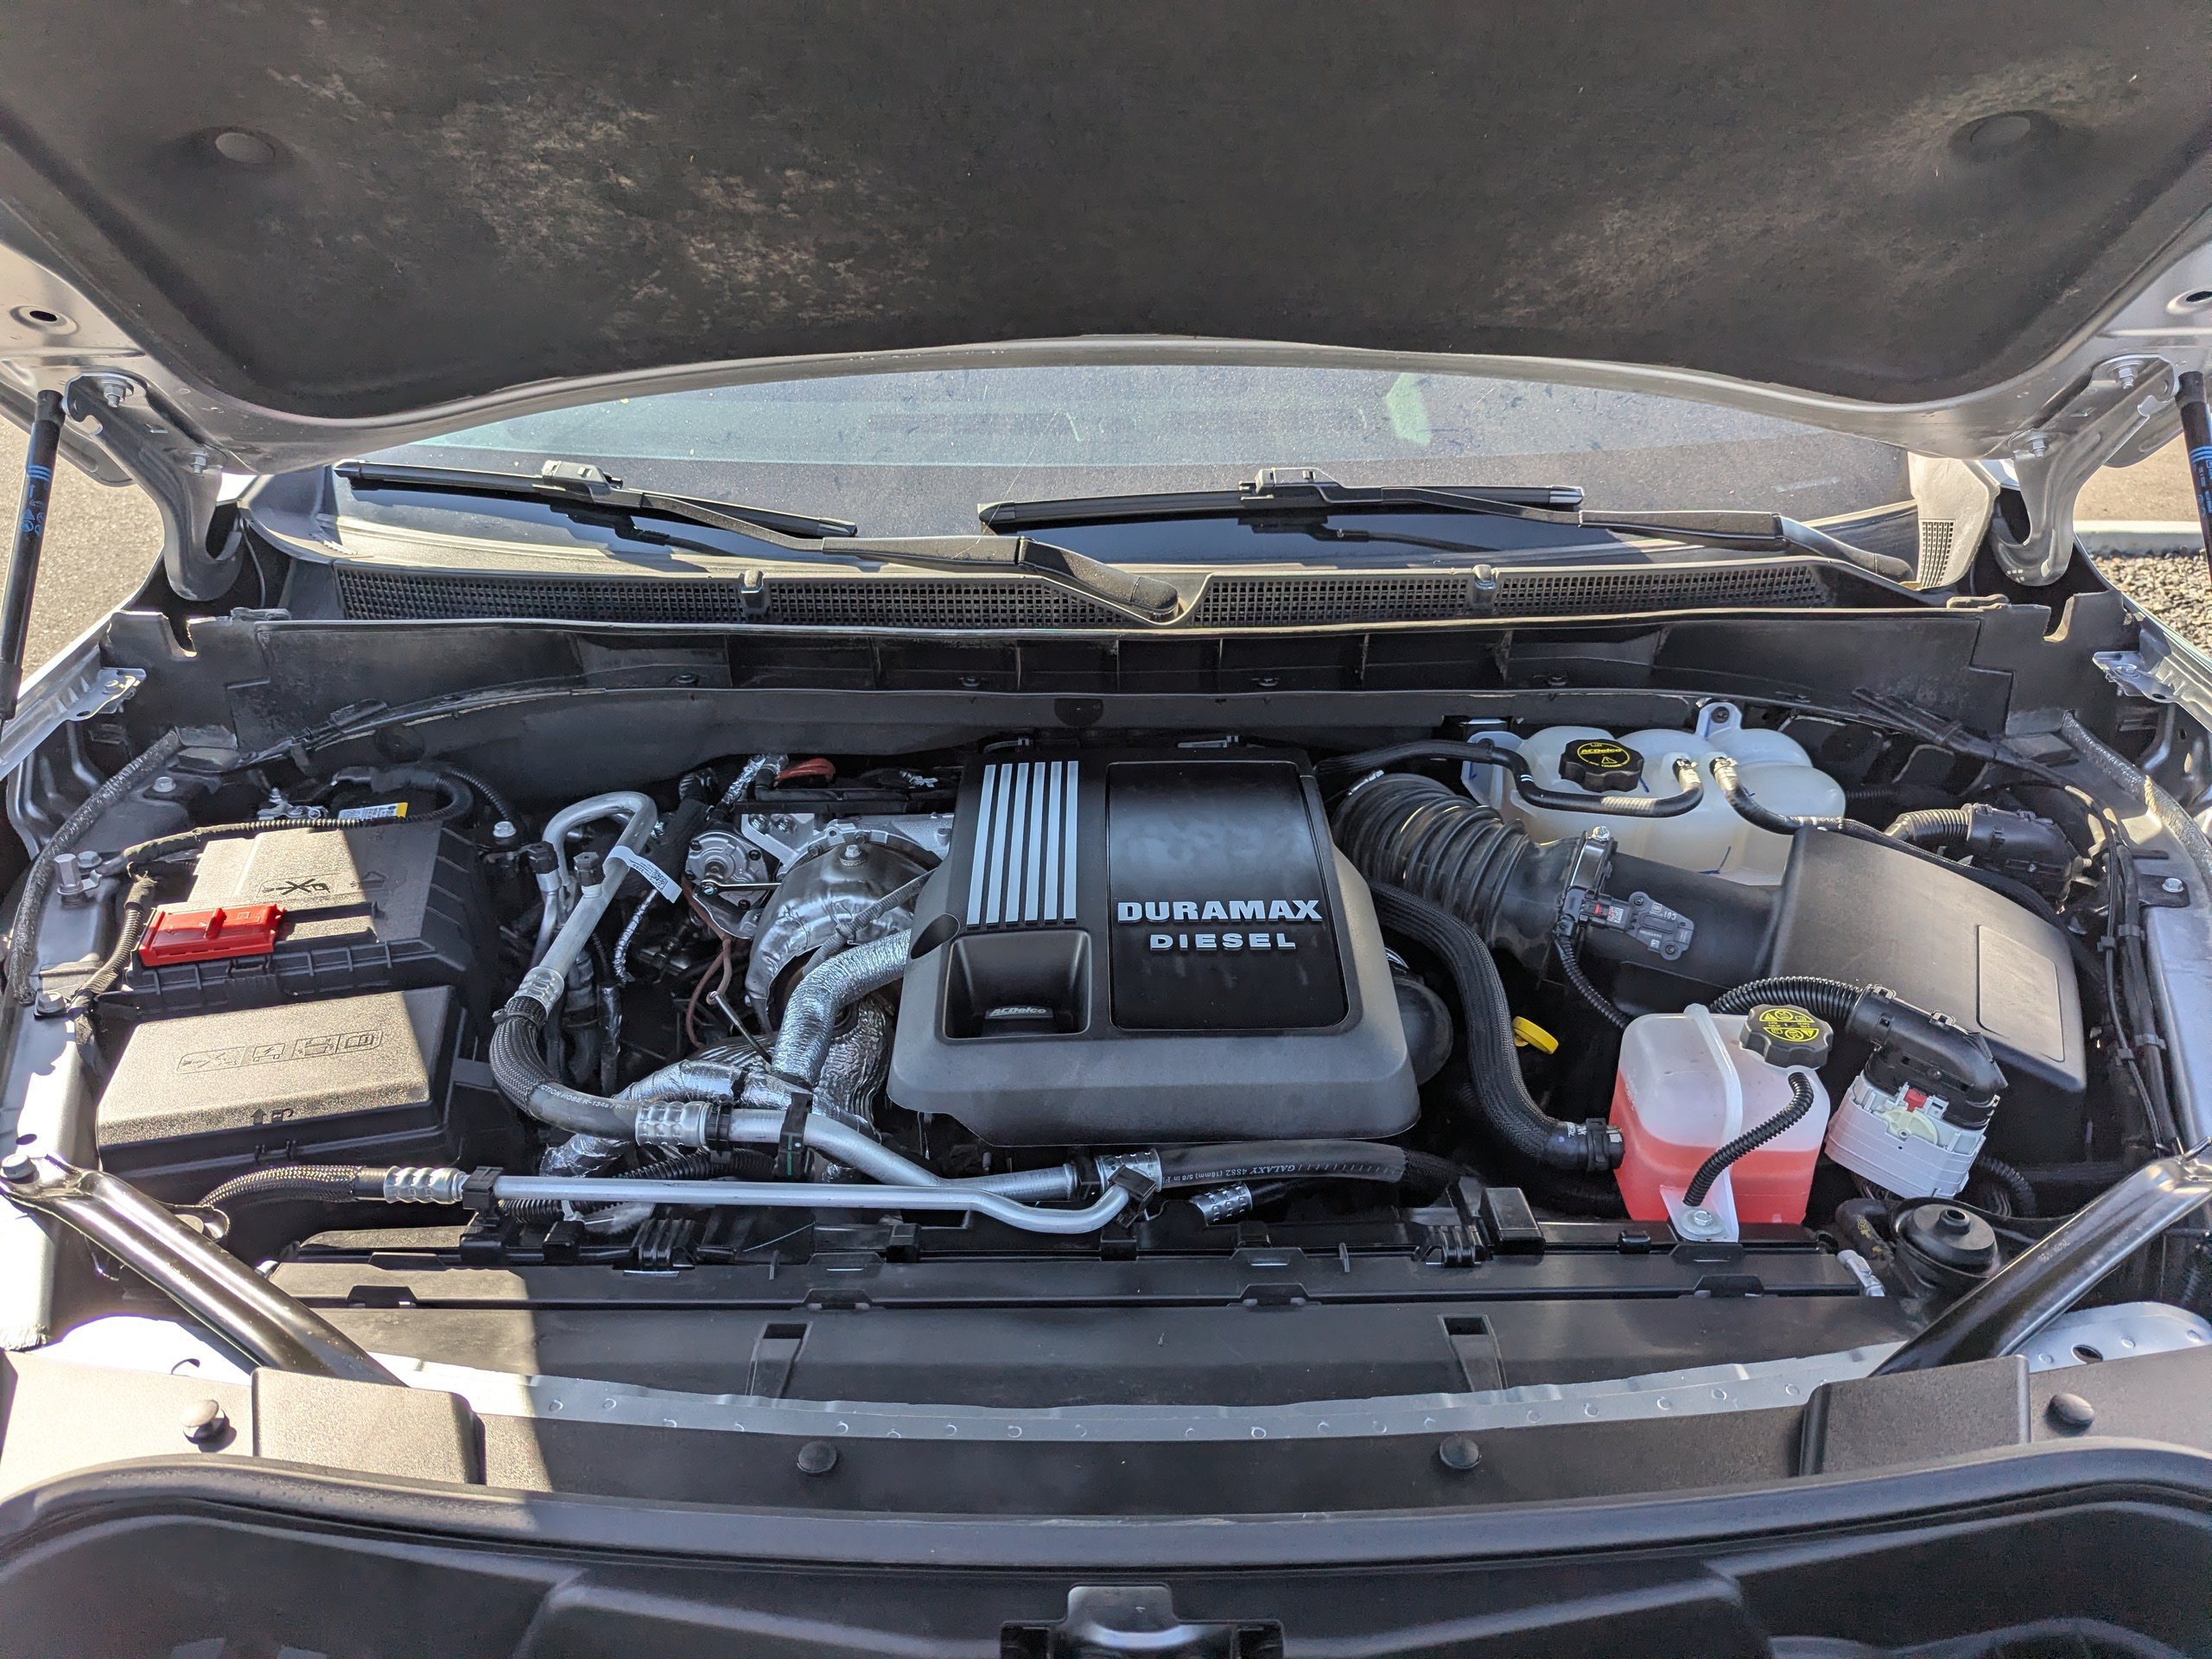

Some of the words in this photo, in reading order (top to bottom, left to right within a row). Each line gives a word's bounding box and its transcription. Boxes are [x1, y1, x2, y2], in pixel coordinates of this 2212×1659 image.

[1117, 900, 1323, 923] DURAMAX
[1149, 933, 1296, 951] DIESEL
[989, 1007, 1047, 1017] ACDelco
[561, 1093, 582, 1103] HOSE
[1195, 1170, 1223, 1179] (16mm)
[1249, 1164, 1296, 1175] GALAXY
